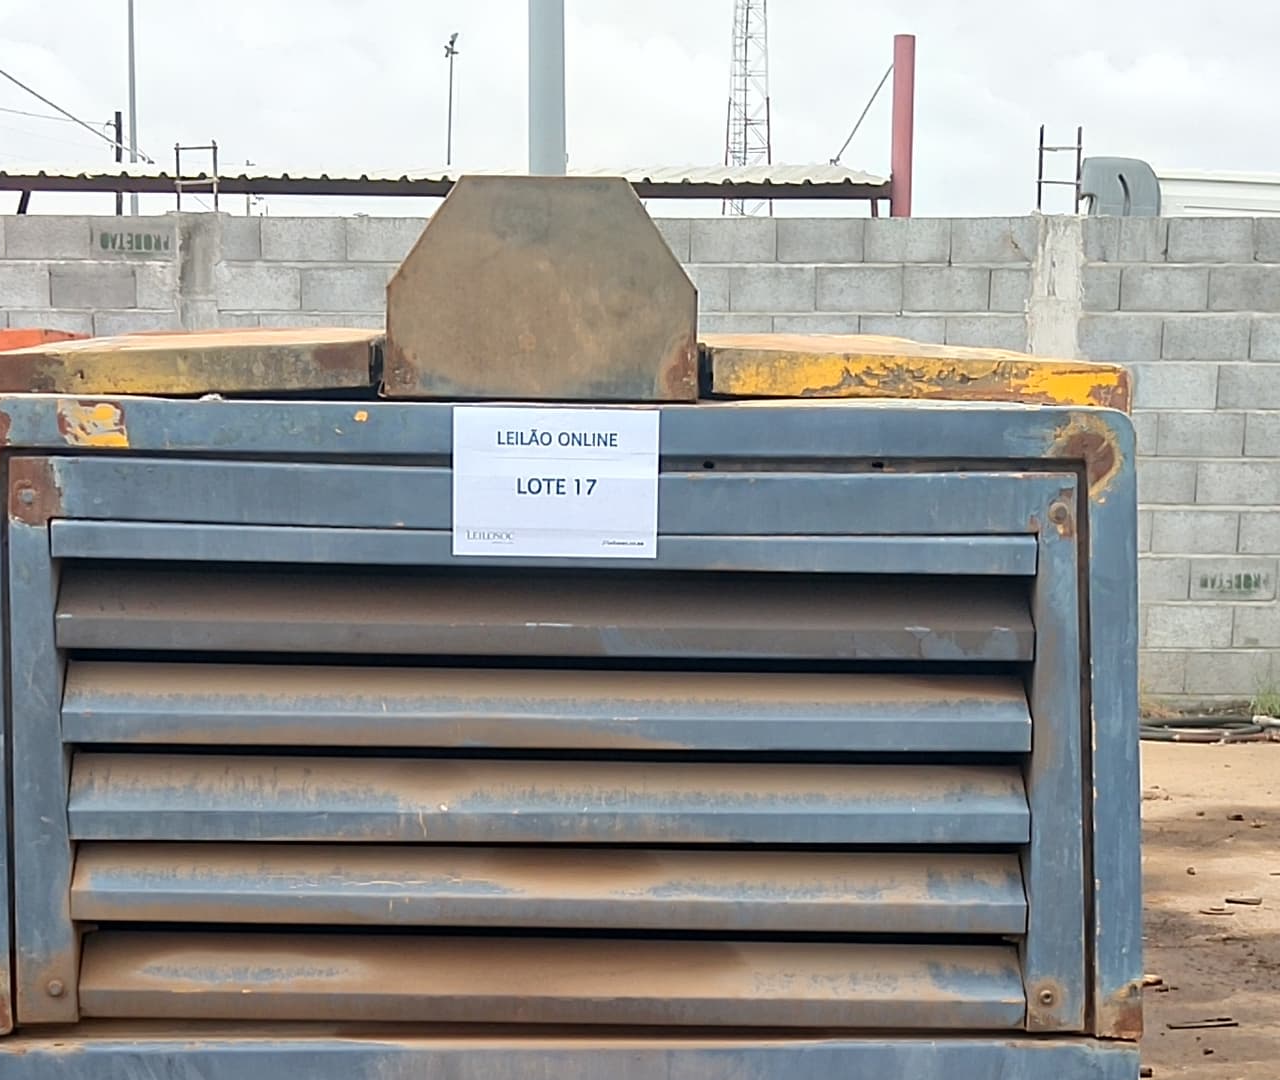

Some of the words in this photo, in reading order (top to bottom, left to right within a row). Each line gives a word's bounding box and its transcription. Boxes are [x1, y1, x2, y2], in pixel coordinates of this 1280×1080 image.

[497, 429, 552, 446] LEILÃO
[558, 432, 618, 447] ONLINE
[517, 478, 566, 495] LOTE
[574, 479, 597, 496] 17
